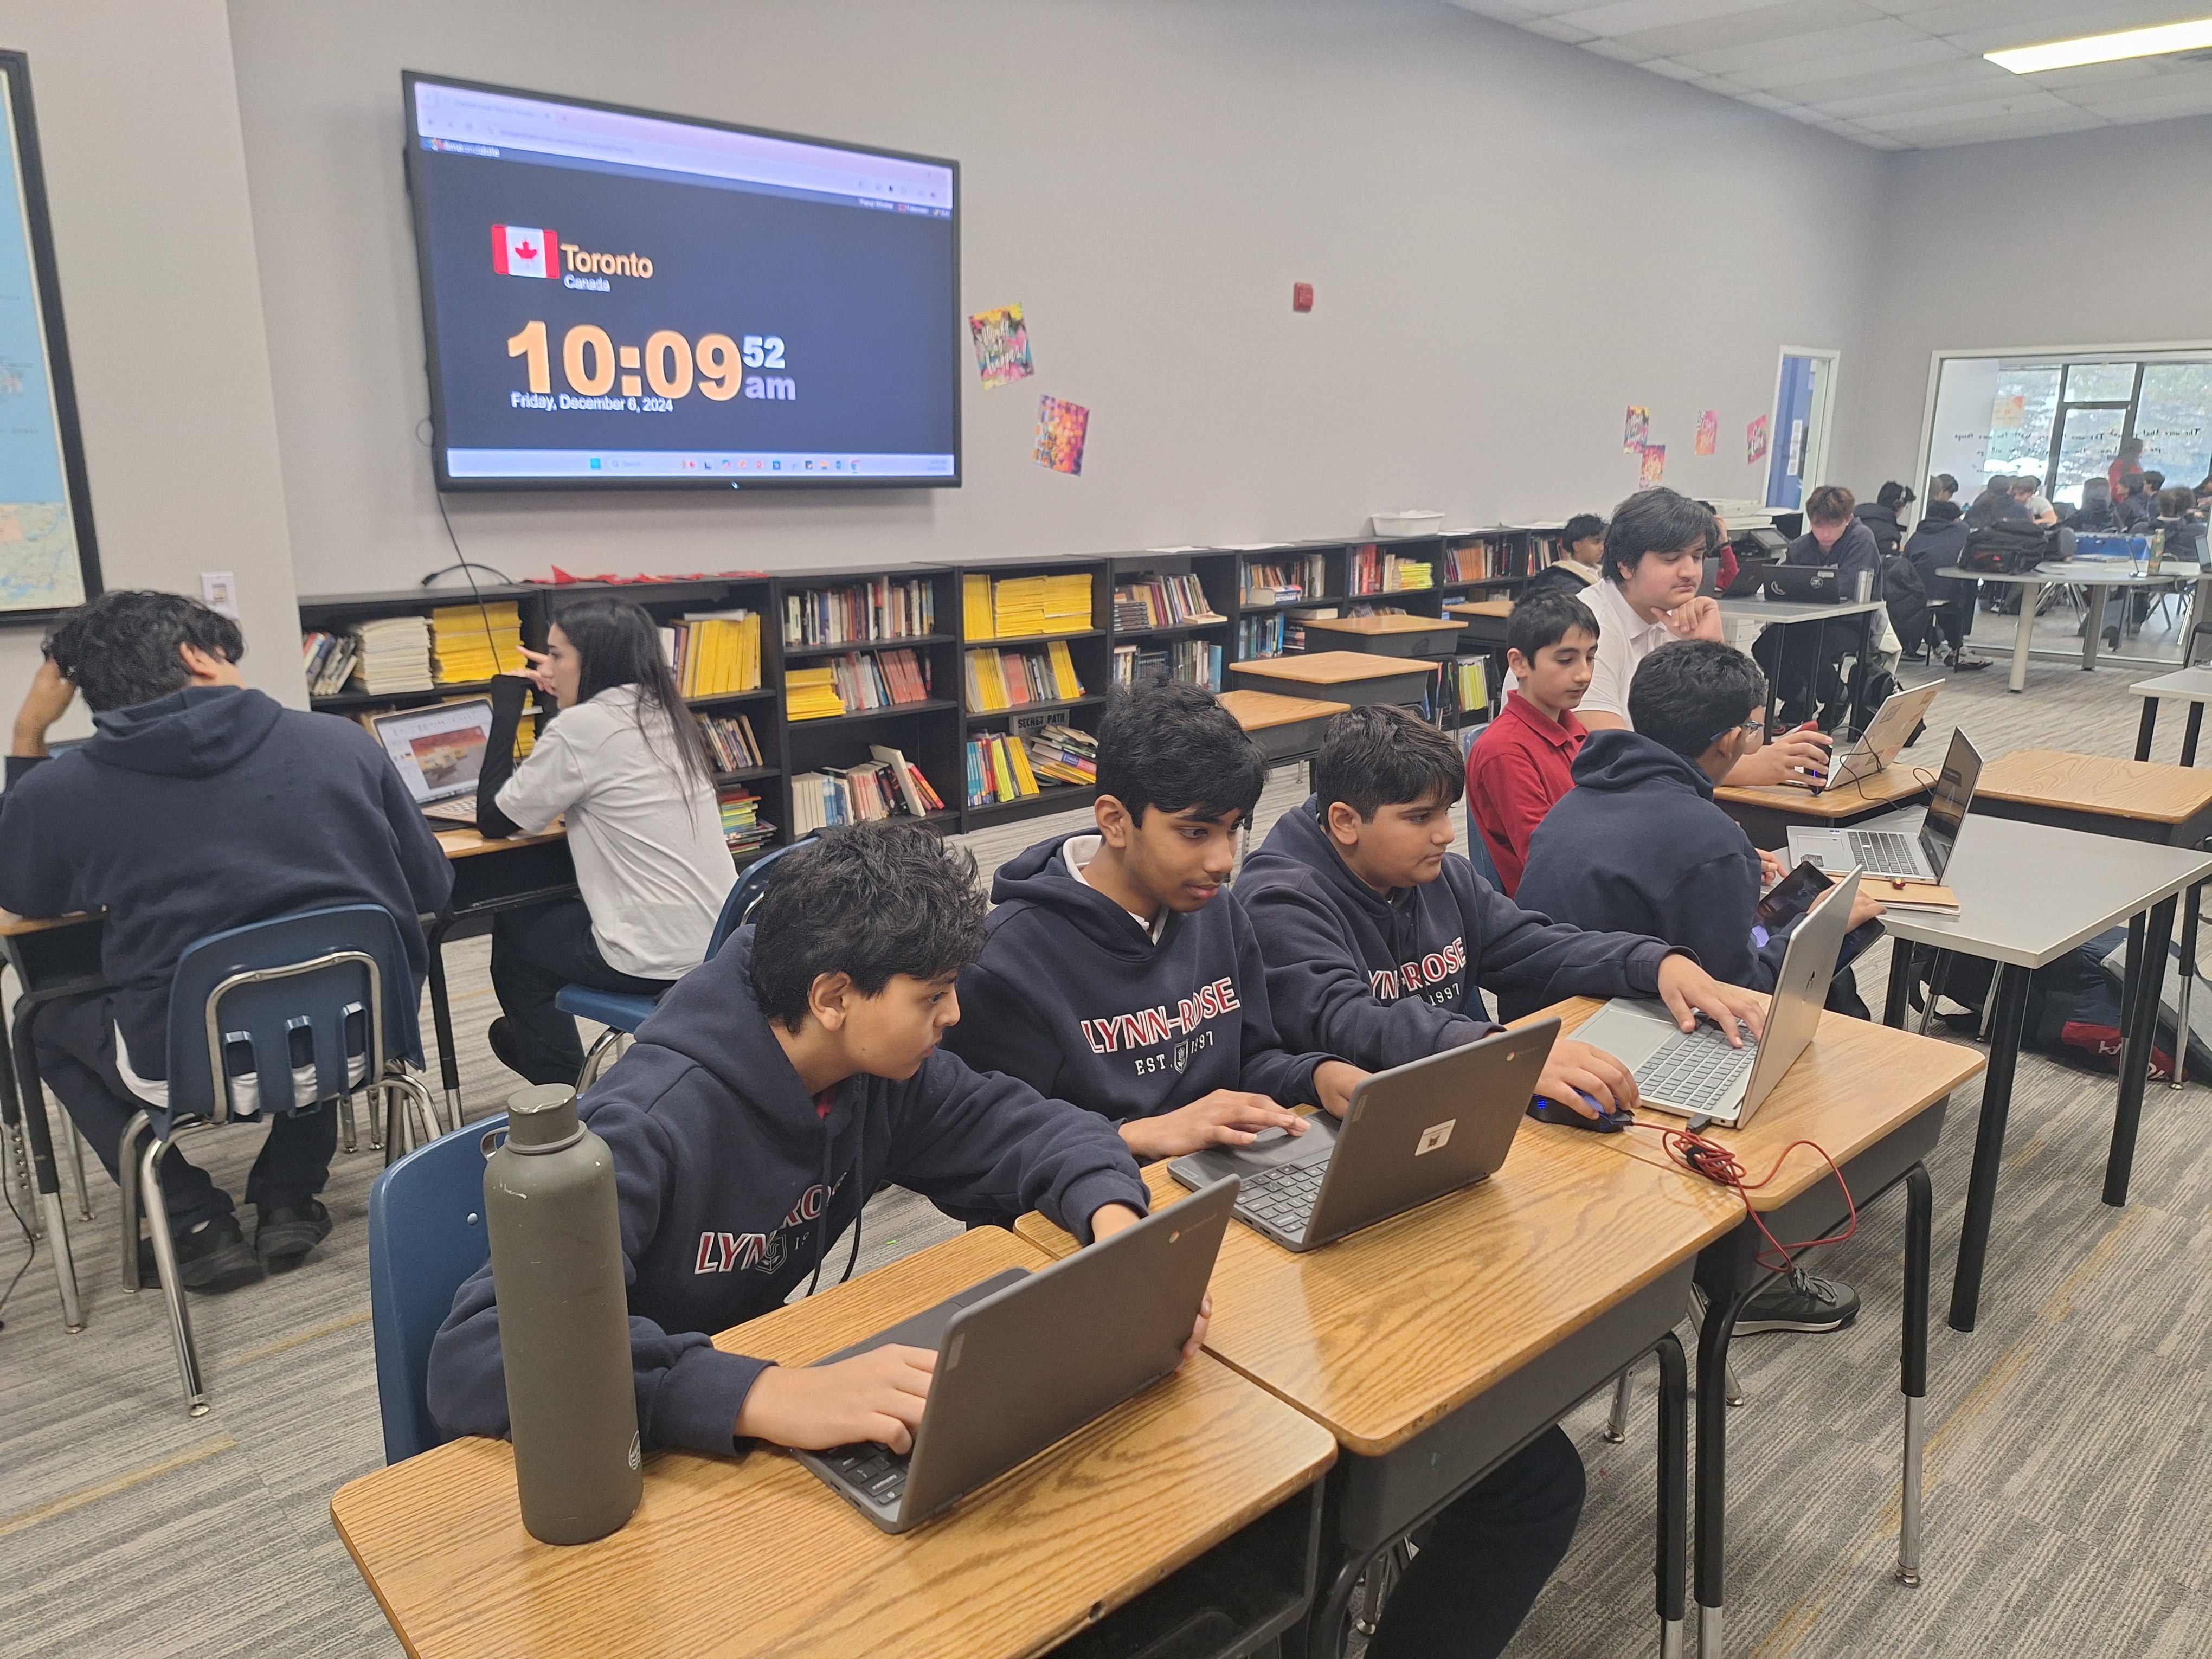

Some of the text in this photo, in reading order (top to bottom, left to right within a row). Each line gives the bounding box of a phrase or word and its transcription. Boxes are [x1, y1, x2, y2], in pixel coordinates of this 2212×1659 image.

[560, 243, 654, 279] Toronto
[564, 274, 610, 292] Canada
[507, 320, 786, 401] 10:09 52
[745, 375, 796, 401] am
[511, 391, 673, 413] Friday, December 6, 2024
[1018, 712, 1065, 729] SECRET PATH
[1429, 982, 1461, 1006] 1997
[1080, 976, 1242, 1054] LYNN-ROSE
[1134, 1054, 1173, 1076] EST.
